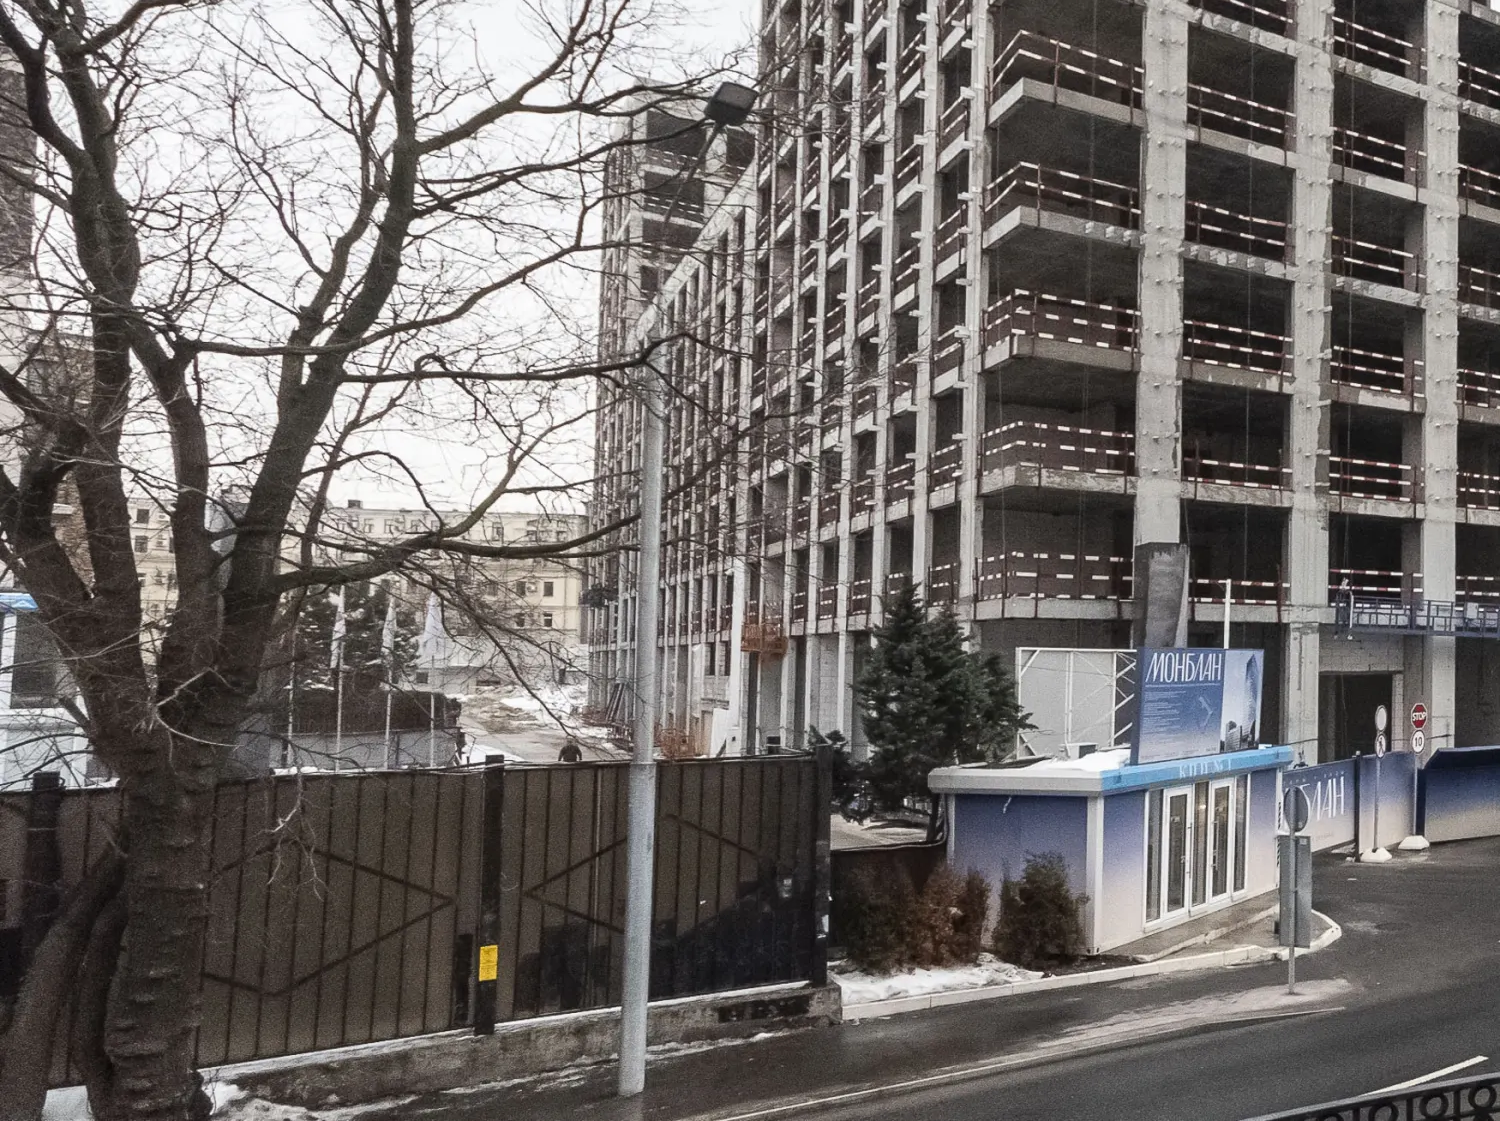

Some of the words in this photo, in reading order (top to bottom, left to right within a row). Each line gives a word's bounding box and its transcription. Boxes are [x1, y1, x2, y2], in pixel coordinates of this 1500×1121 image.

[1145, 652, 1222, 683] МОНБЛАН
[1412, 711, 1427, 721] STOP
[1414, 736, 1423, 747] 10
